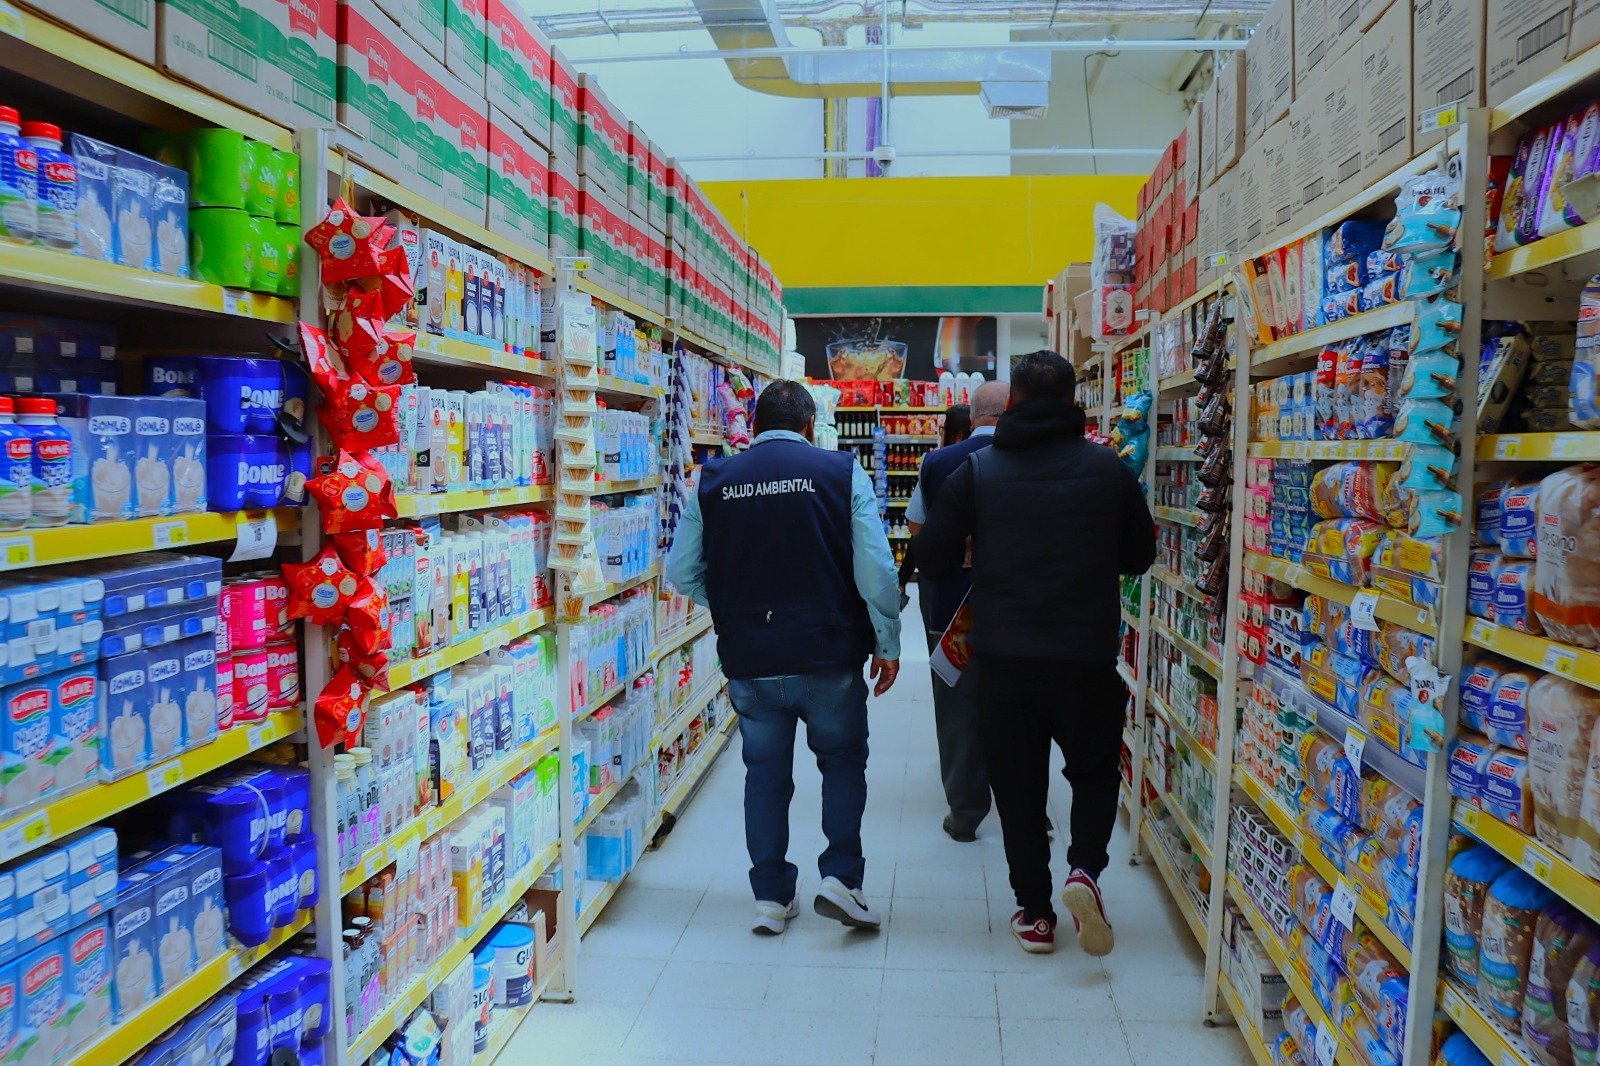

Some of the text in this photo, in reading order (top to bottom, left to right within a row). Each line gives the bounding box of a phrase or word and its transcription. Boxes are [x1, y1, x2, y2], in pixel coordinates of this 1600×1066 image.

[289, 0, 317, 21] Metro
[368, 46, 389, 71] Metro
[417, 88, 435, 108] Metro
[722, 479, 816, 501] SALUD AMBIENTAL
